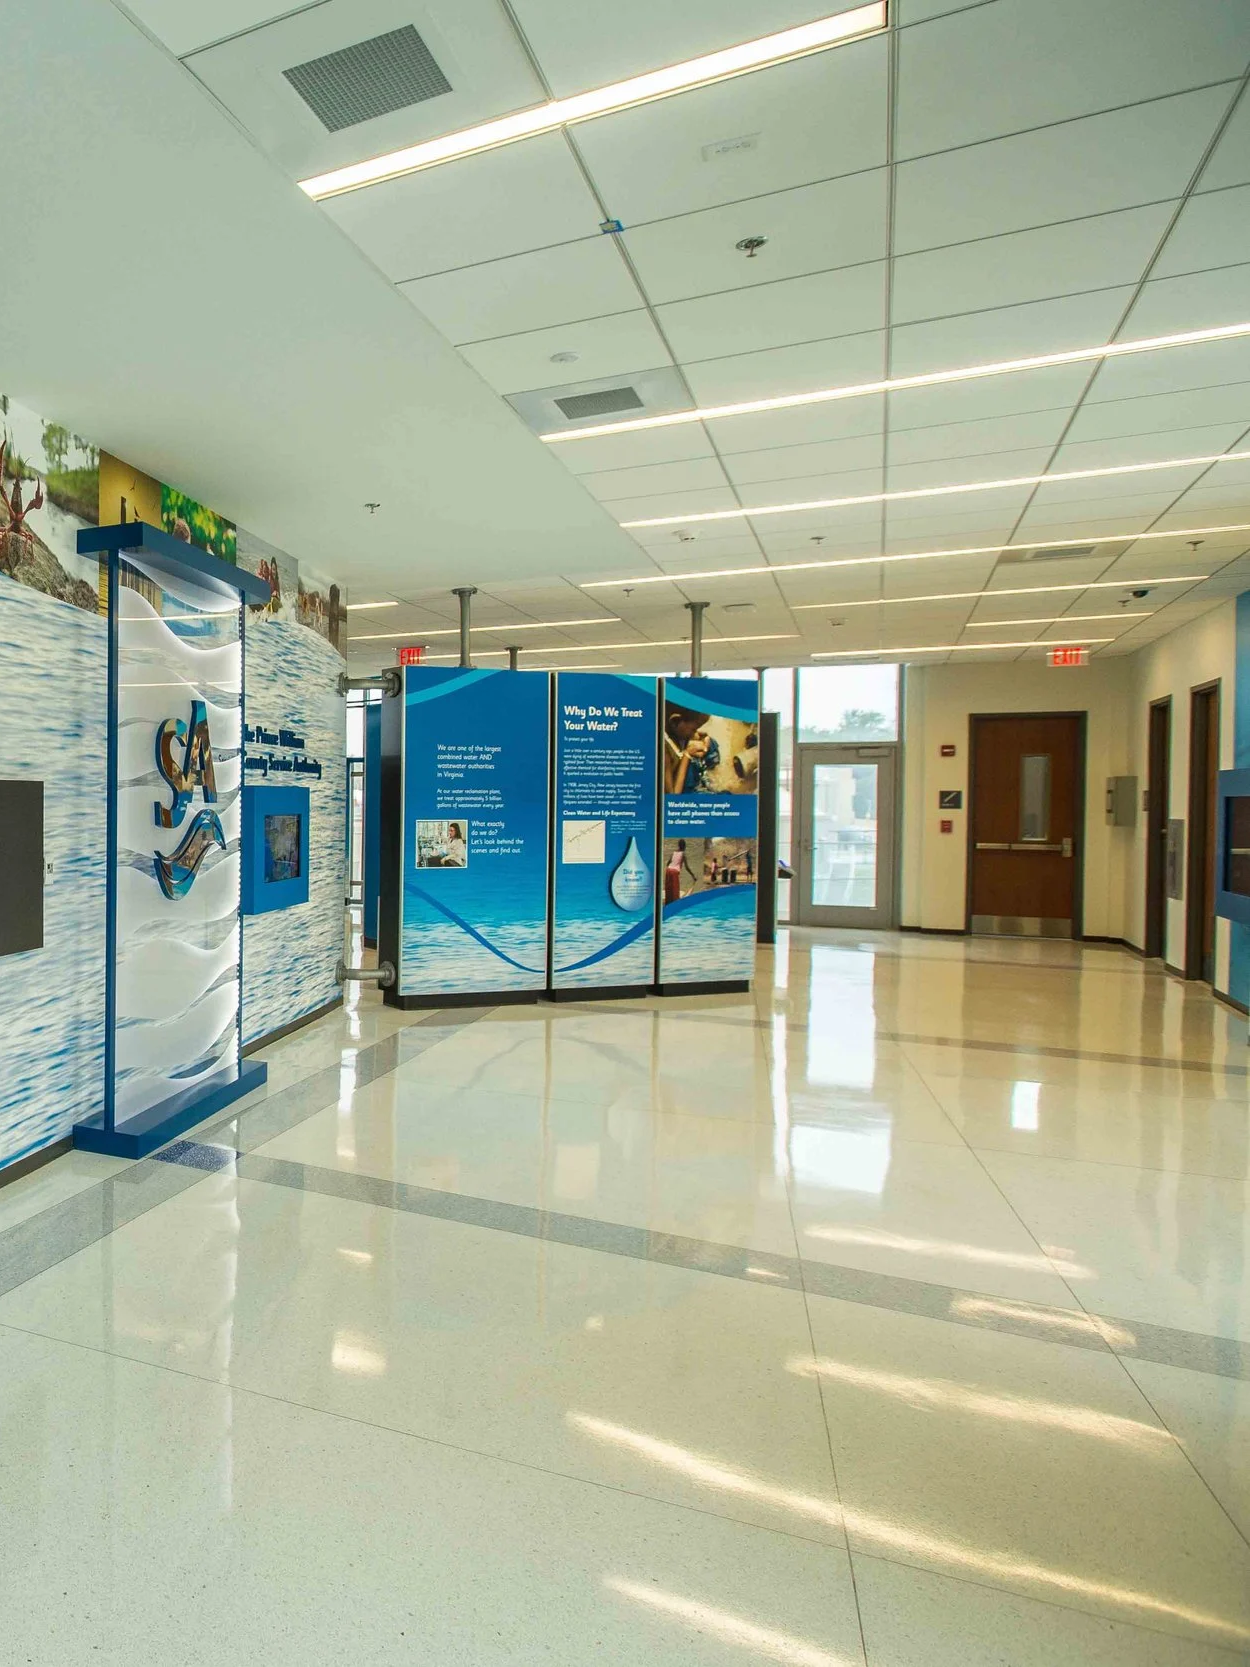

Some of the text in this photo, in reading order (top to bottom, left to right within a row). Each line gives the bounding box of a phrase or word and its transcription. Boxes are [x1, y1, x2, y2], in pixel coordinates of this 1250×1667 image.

[400, 648, 422, 665] EXIT
[1053, 647, 1082, 665] EXIT
[564, 706, 643, 719] Why Do We Treat
[564, 721, 618, 731] Your Water?
[468, 745, 474, 753] of
[484, 746, 501, 754] largest
